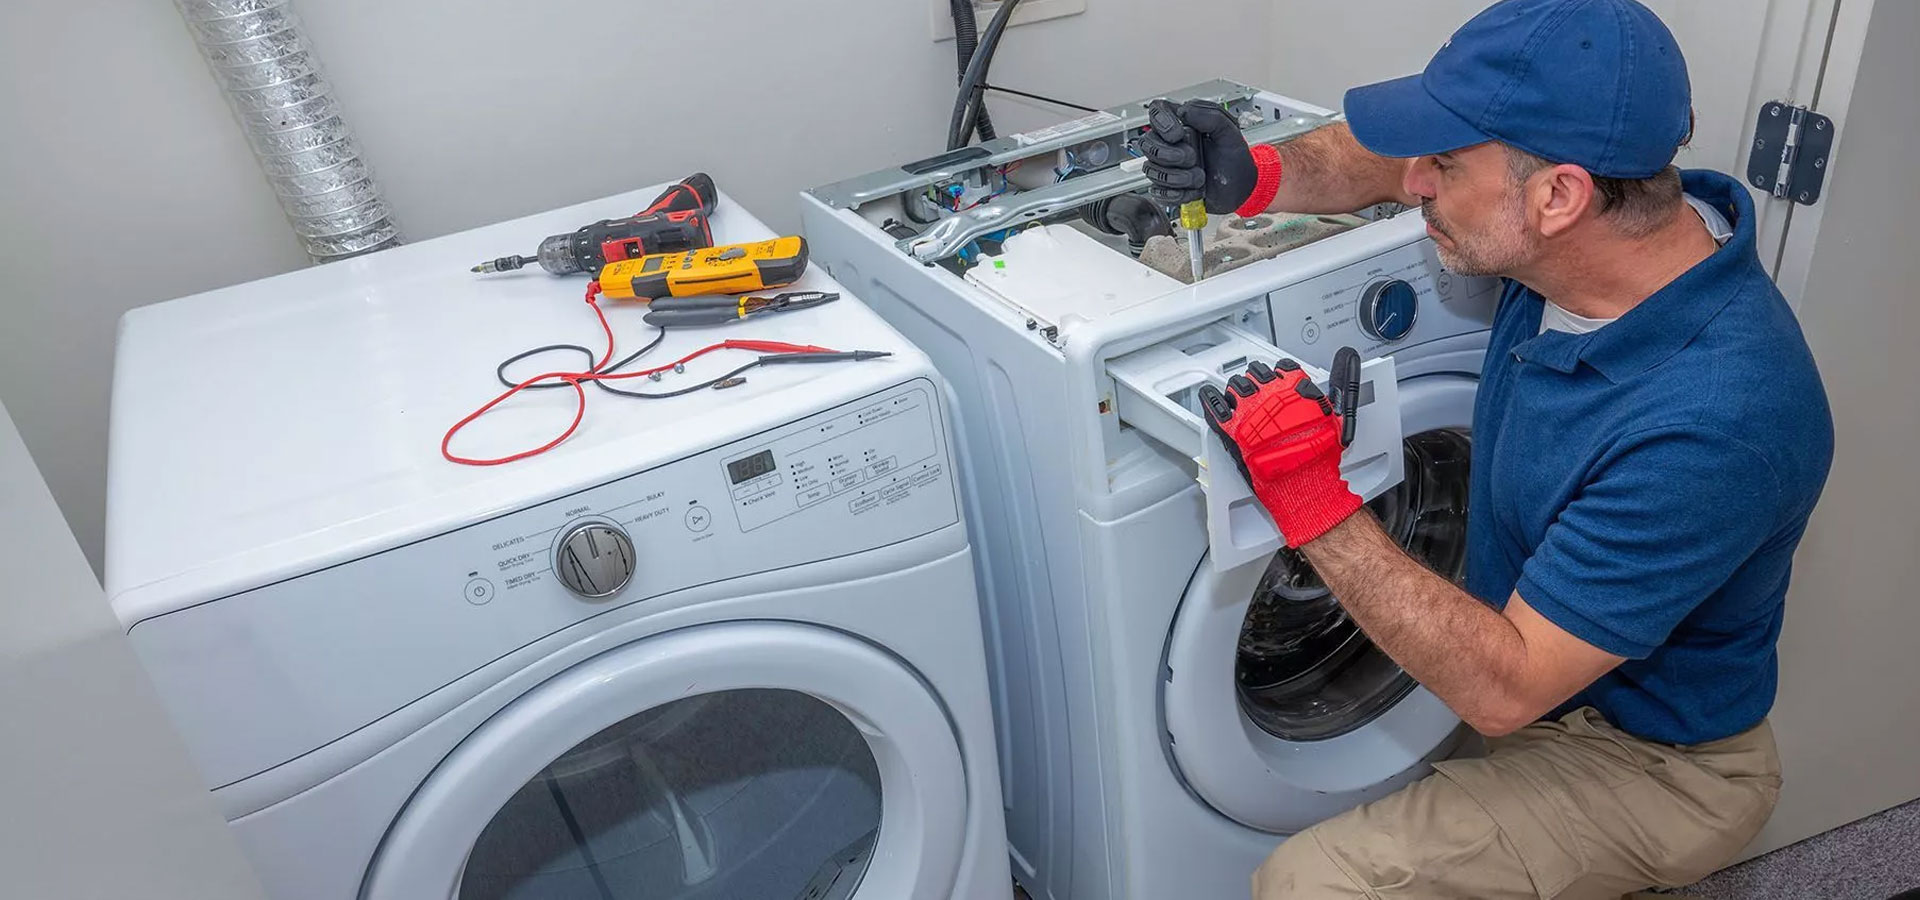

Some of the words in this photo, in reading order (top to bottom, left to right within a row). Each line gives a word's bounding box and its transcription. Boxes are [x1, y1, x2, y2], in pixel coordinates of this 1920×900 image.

[647, 492, 665, 501] BULKY
[565, 505, 591, 517] NORMAL
[635, 513, 653, 522] HEAVY
[653, 506, 671, 517] DUTY
[491, 536, 525, 551] DELICATES
[497, 557, 516, 567] QUICK
[517, 553, 530, 561] DRY
[504, 575, 523, 585] TIMED
[523, 572, 536, 580] DRY
